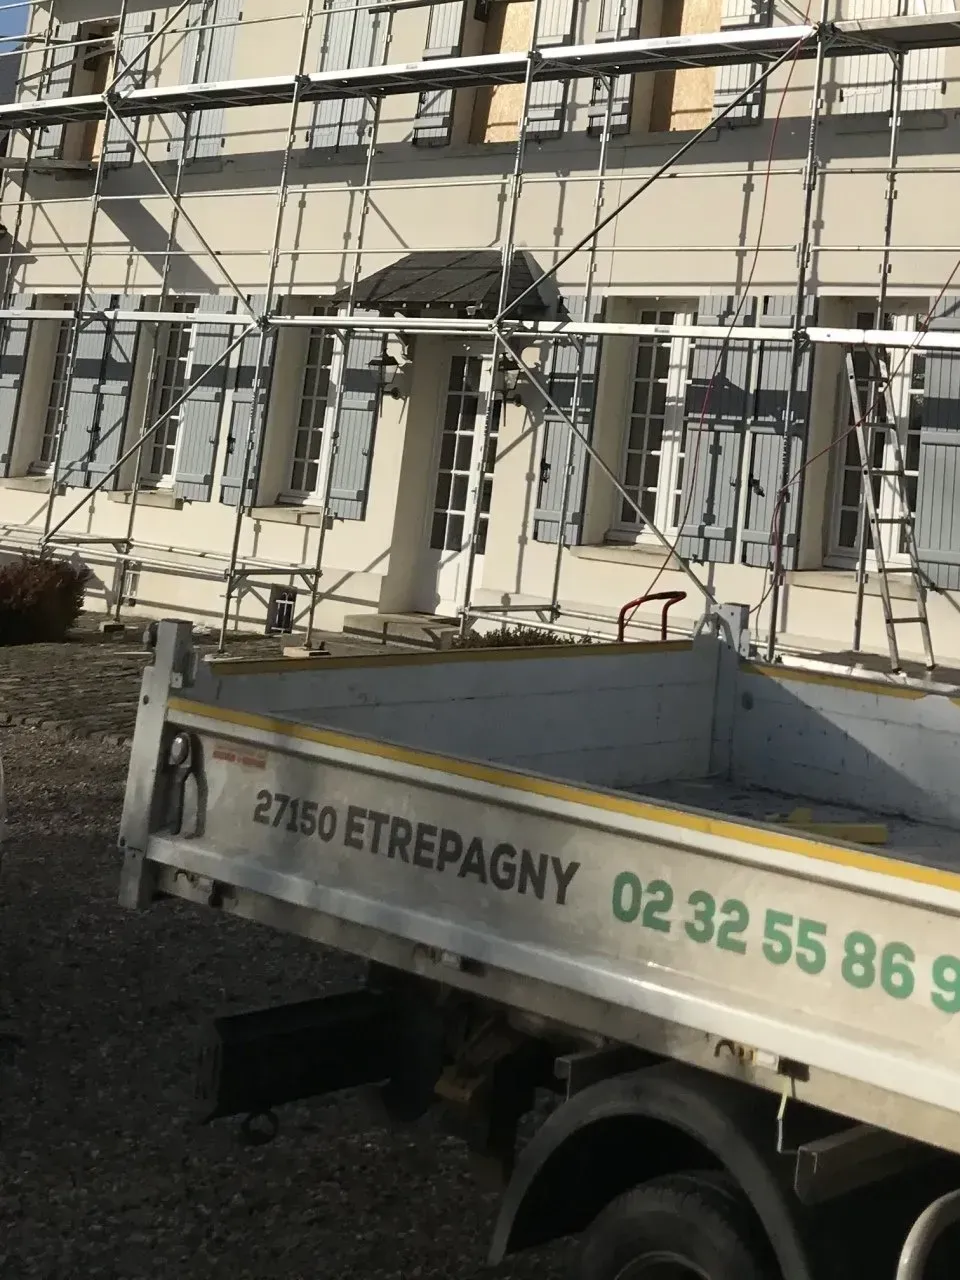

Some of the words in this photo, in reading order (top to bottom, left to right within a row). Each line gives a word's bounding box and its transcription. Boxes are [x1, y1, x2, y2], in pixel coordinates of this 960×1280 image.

[253, 789, 337, 844] 27150
[343, 805, 581, 905] ETREPAGNY
[612, 871, 673, 932] 02
[684, 891, 750, 955] 32
[762, 908, 827, 974] 55
[841, 931, 916, 999] 86
